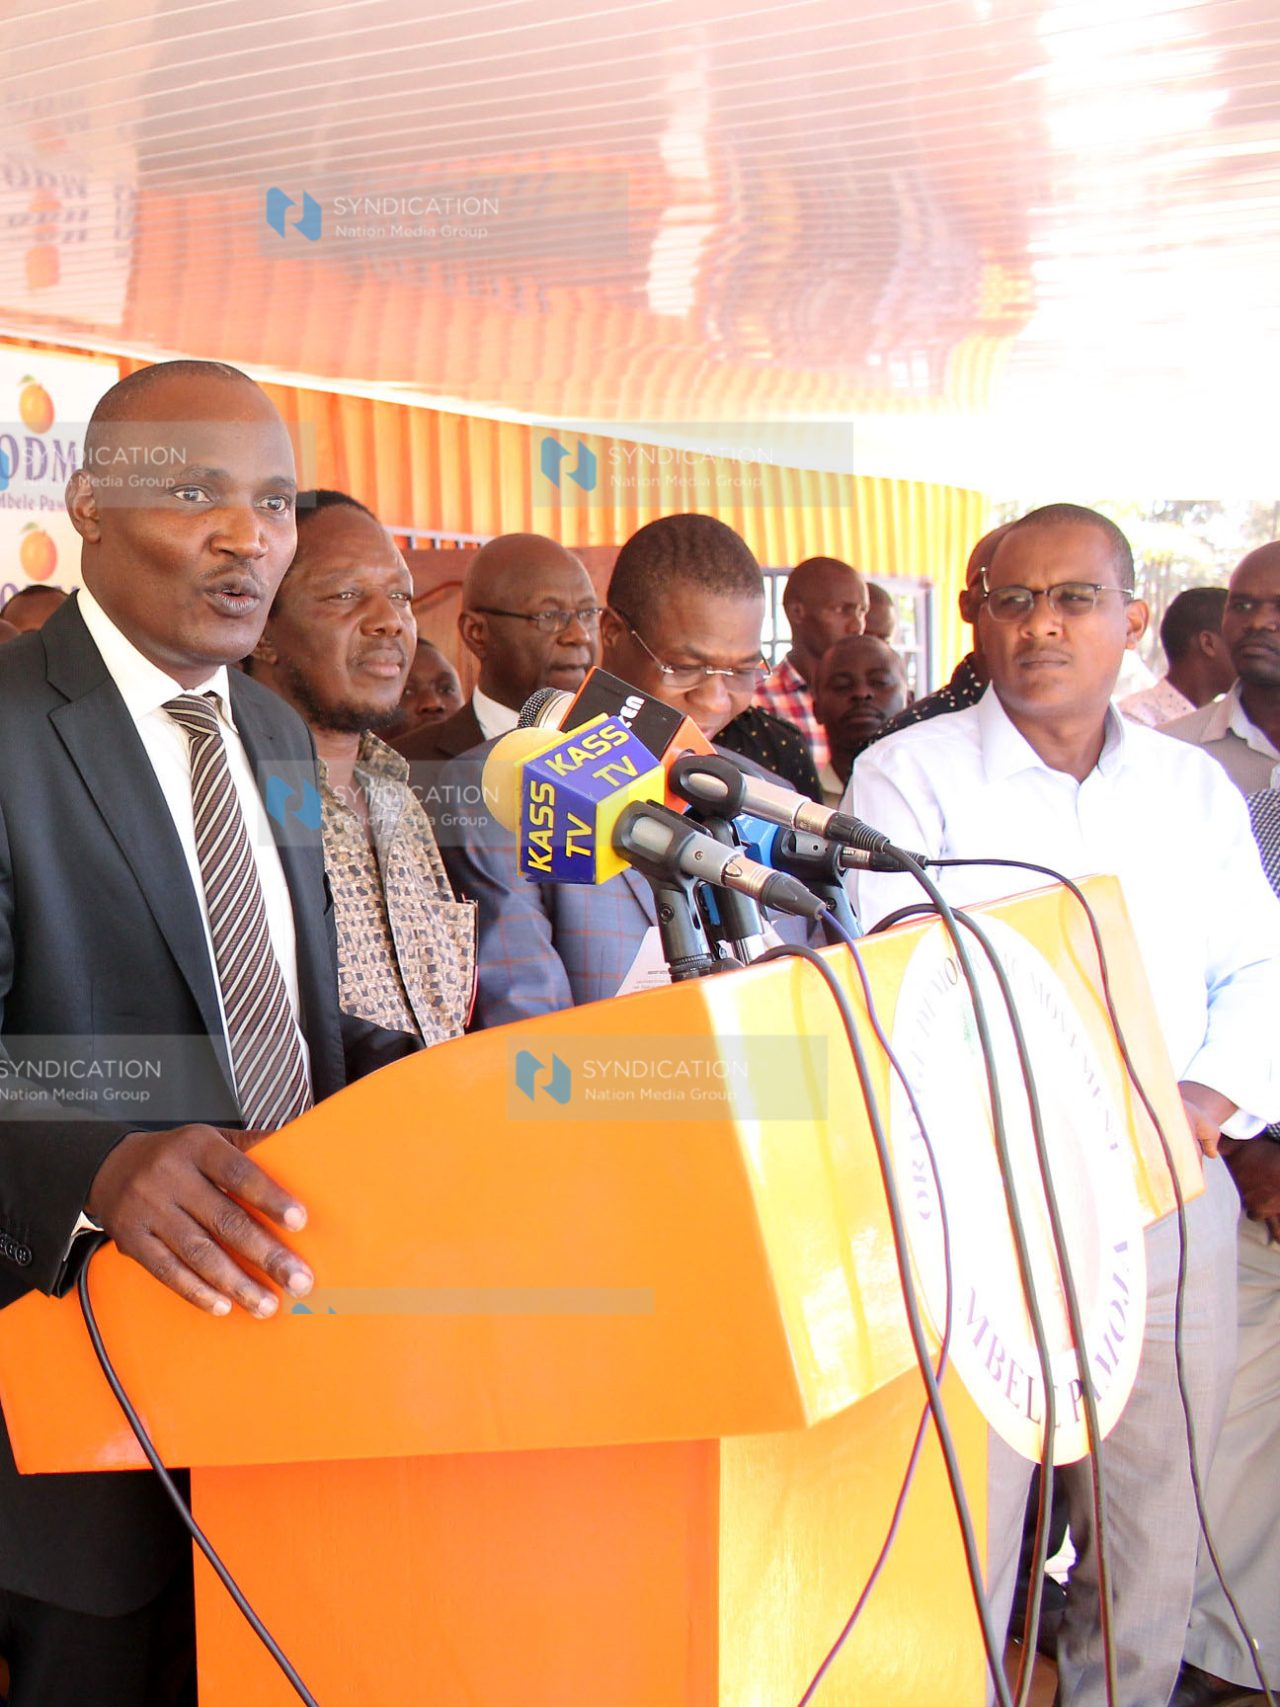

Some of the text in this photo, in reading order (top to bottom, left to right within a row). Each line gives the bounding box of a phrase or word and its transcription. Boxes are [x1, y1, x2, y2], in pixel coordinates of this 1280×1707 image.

[544, 725, 630, 777] KASS
[592, 755, 640, 788] TV
[527, 780, 556, 873] KASS
[566, 812, 593, 858] TV
